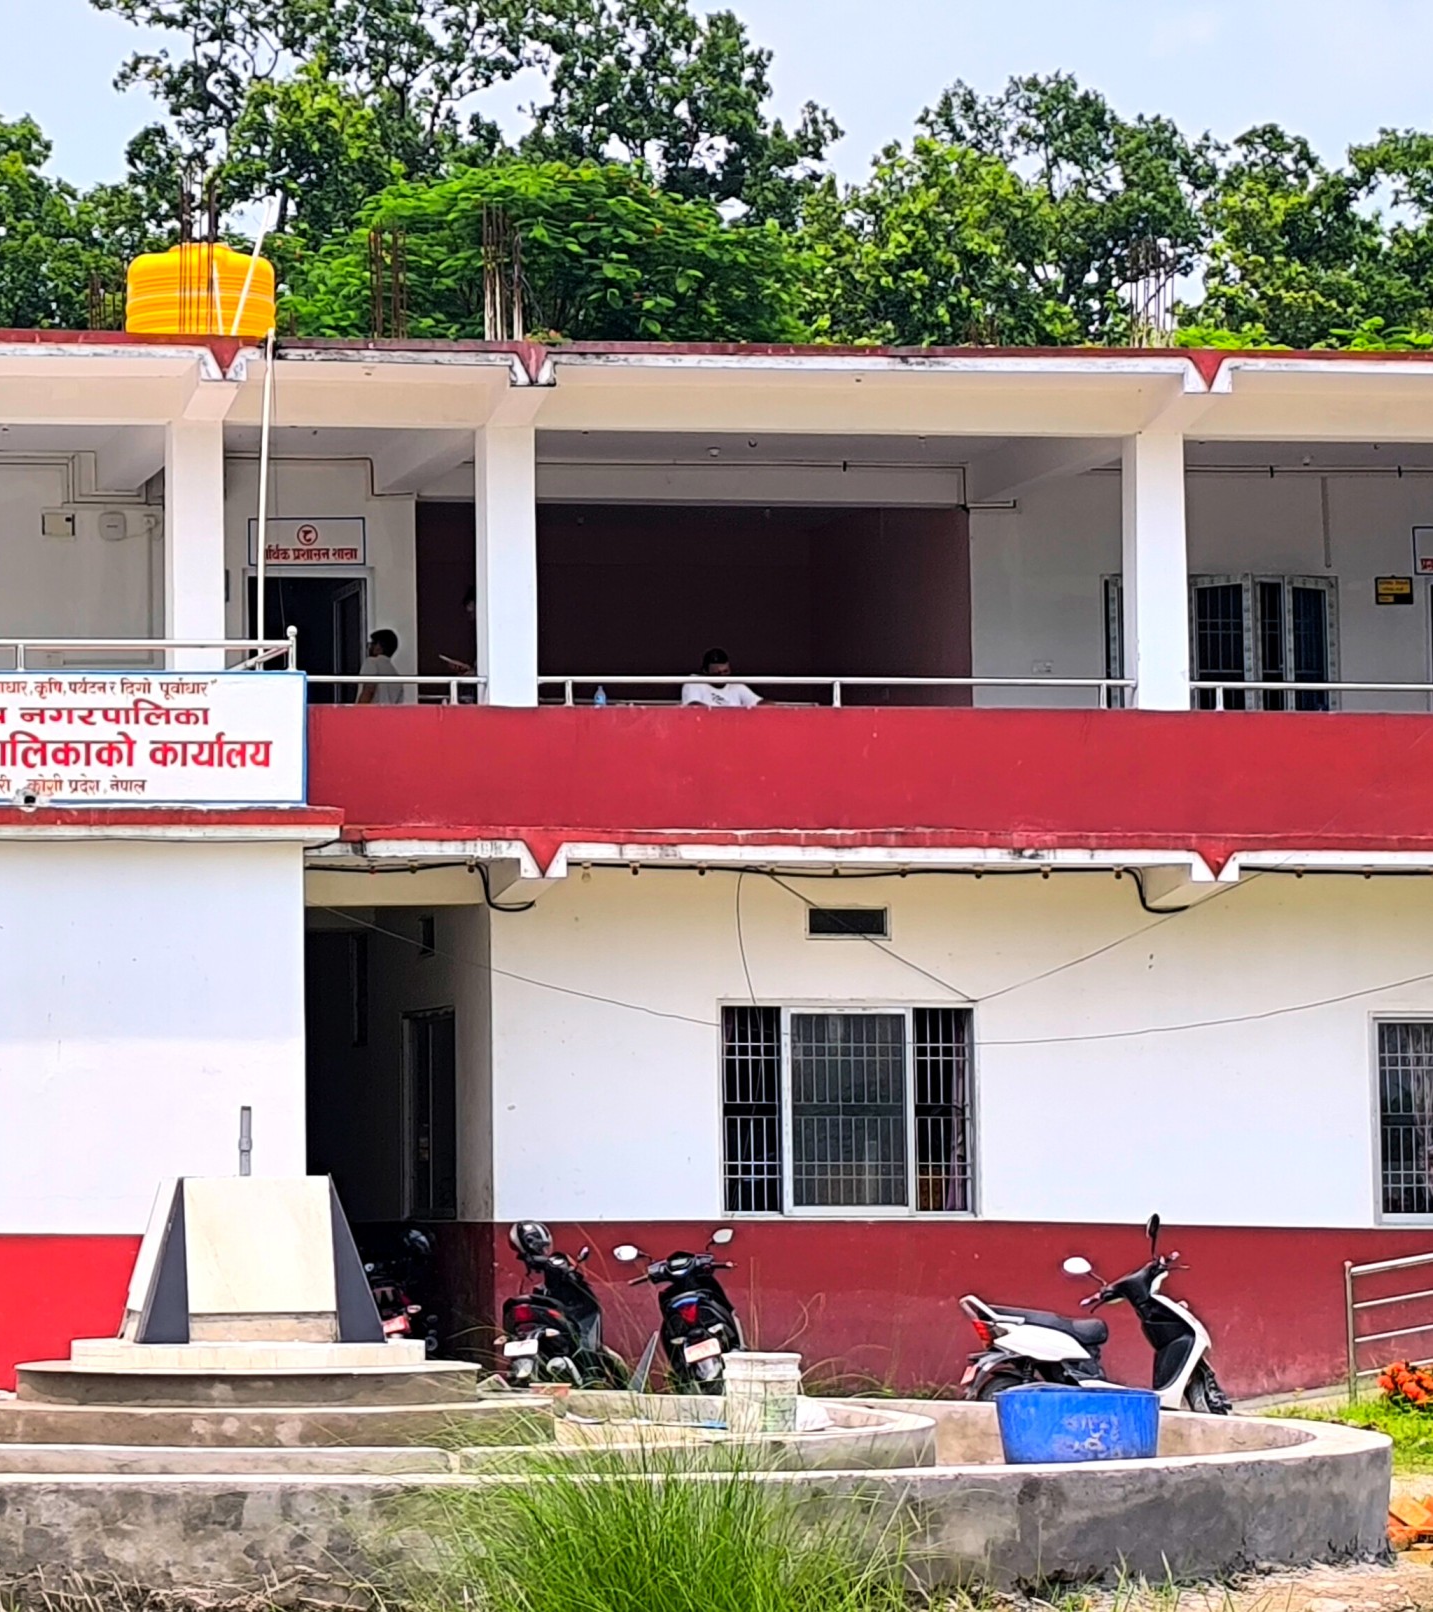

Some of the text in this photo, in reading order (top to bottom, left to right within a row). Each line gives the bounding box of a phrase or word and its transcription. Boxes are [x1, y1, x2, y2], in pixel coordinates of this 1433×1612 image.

[68, 676, 107, 694] पर्यटन
[120, 677, 152, 696] दिगो
[19, 697, 210, 726] नगरपालिका
[149, 731, 273, 768] कार्यालय
[109, 774, 148, 794] नेपाल
